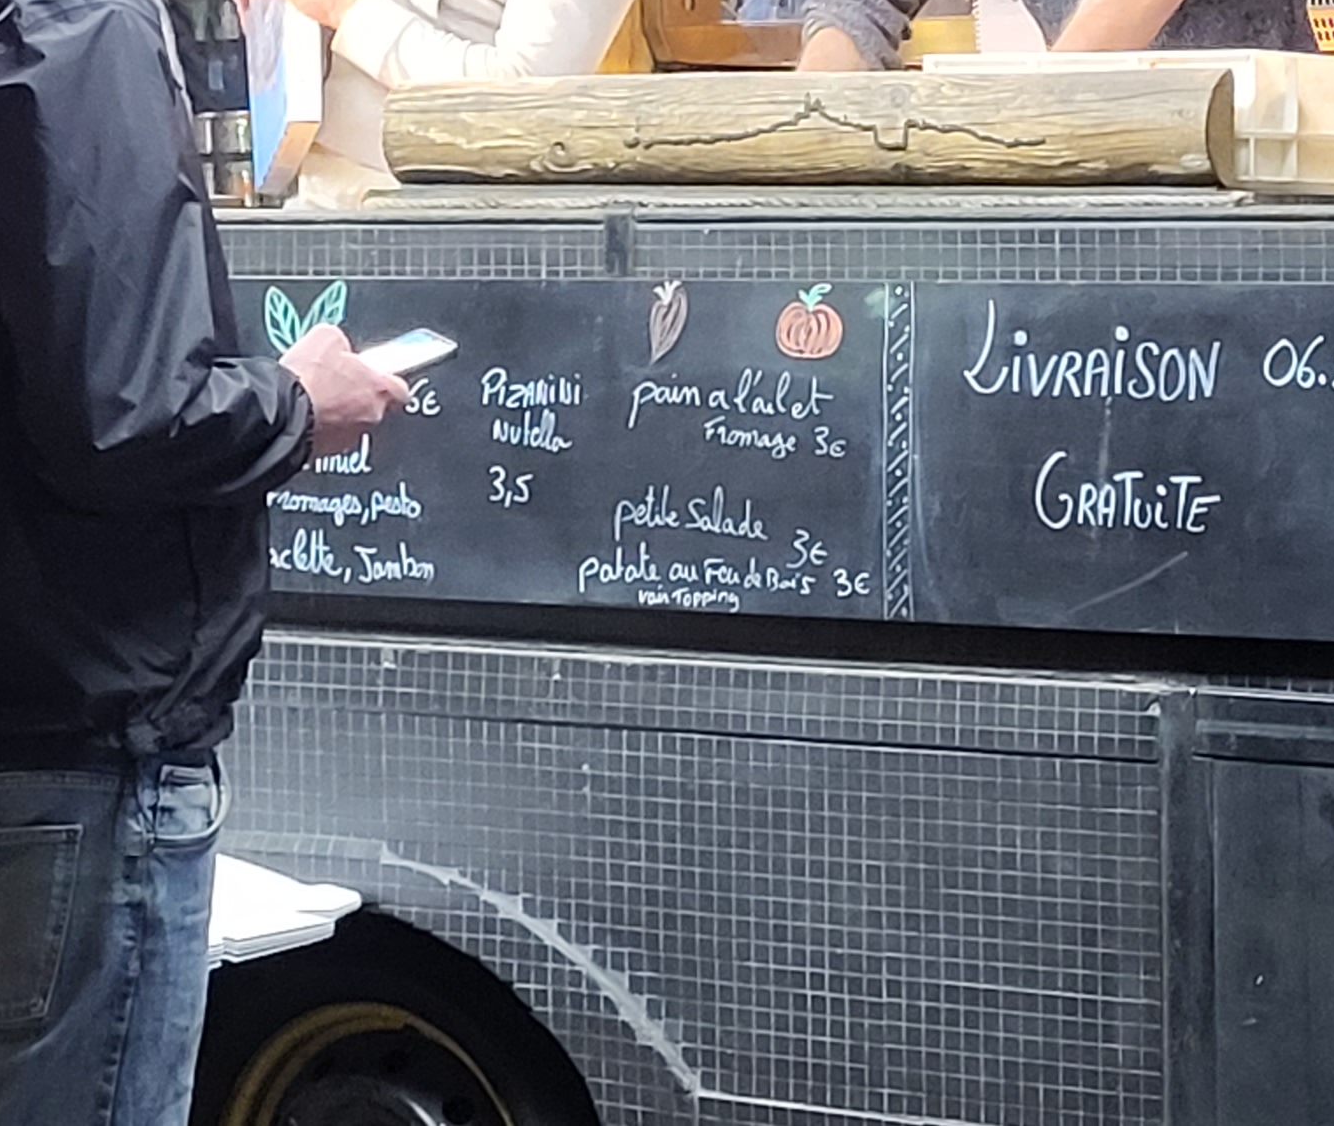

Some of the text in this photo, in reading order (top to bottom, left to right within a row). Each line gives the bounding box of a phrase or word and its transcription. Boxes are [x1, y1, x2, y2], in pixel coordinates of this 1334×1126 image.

[628, 373, 701, 428] pain
[791, 375, 835, 419] et
[703, 415, 848, 459] Fromage 3€
[488, 465, 535, 508] 3,5
[353, 541, 436, 584] Jambon
[578, 541, 661, 593] patate
[668, 560, 700, 584] au
[832, 567, 872, 598] 3€
[786, 529, 830, 569] 3€
